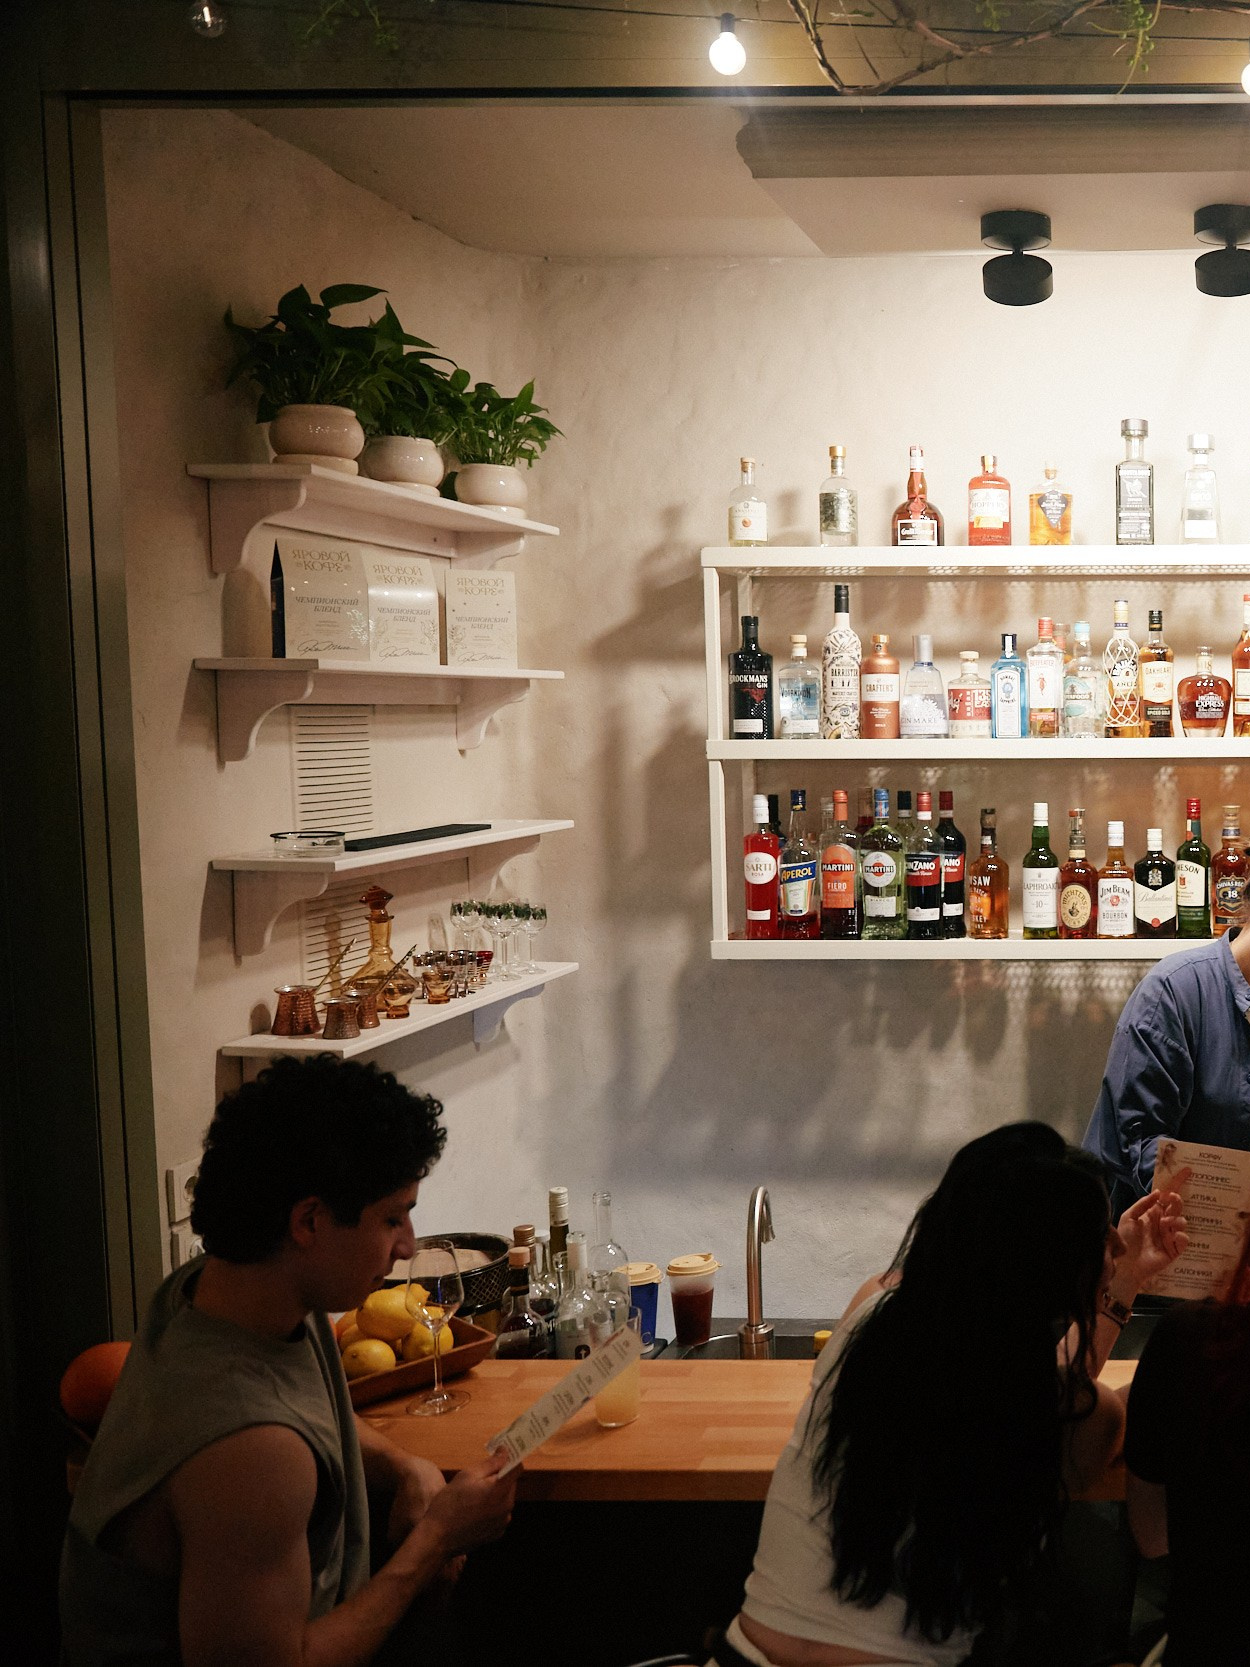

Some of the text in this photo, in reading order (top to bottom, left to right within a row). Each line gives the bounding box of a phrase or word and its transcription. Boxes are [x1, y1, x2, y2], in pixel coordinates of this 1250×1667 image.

[292, 549, 351, 562] ЯРОВОЙ
[373, 564, 423, 576] ЯРОВОЙ
[456, 577, 505, 587] ЯРОВОЙ
[295, 596, 359, 606] ЧЕМПИОНСКИЙ
[314, 605, 341, 614] БЛЕНД
[975, 700, 990, 708] EAS
[1196, 700, 1225, 708] EXPRESS
[745, 863, 772, 872] SARTI
[782, 867, 812, 881] APEROL
[828, 882, 847, 890] FIERO
[1100, 884, 1131, 898] JIM BEAM
[1228, 890, 1238, 898] 18
[1035, 900, 1043, 908] 10
[1190, 1194, 1217, 1202] АТТИКА
